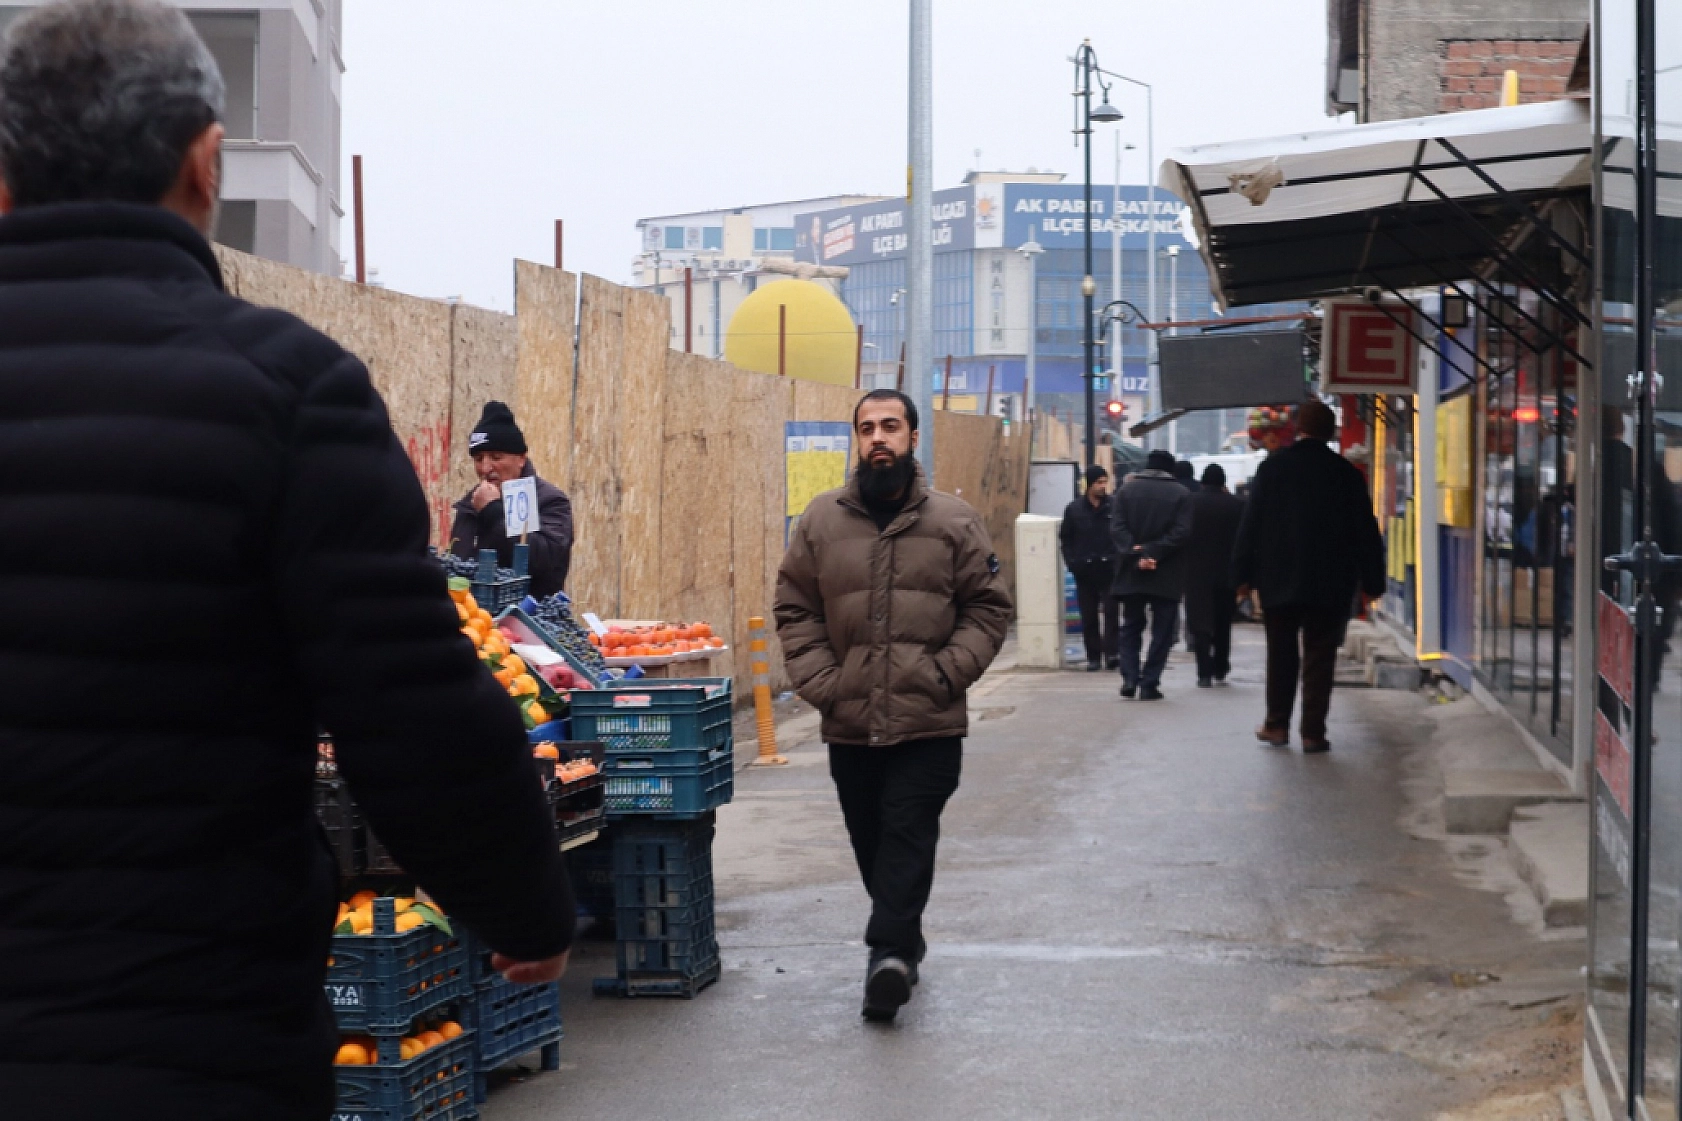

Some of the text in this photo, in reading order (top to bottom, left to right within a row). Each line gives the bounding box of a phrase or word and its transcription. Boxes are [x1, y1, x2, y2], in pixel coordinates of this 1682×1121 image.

[1014, 198, 1043, 213] AK
[1115, 200, 1184, 215] BATTAL
[1043, 217, 1184, 236] İLÇE BAŞKANL
[1347, 316, 1397, 374] E
